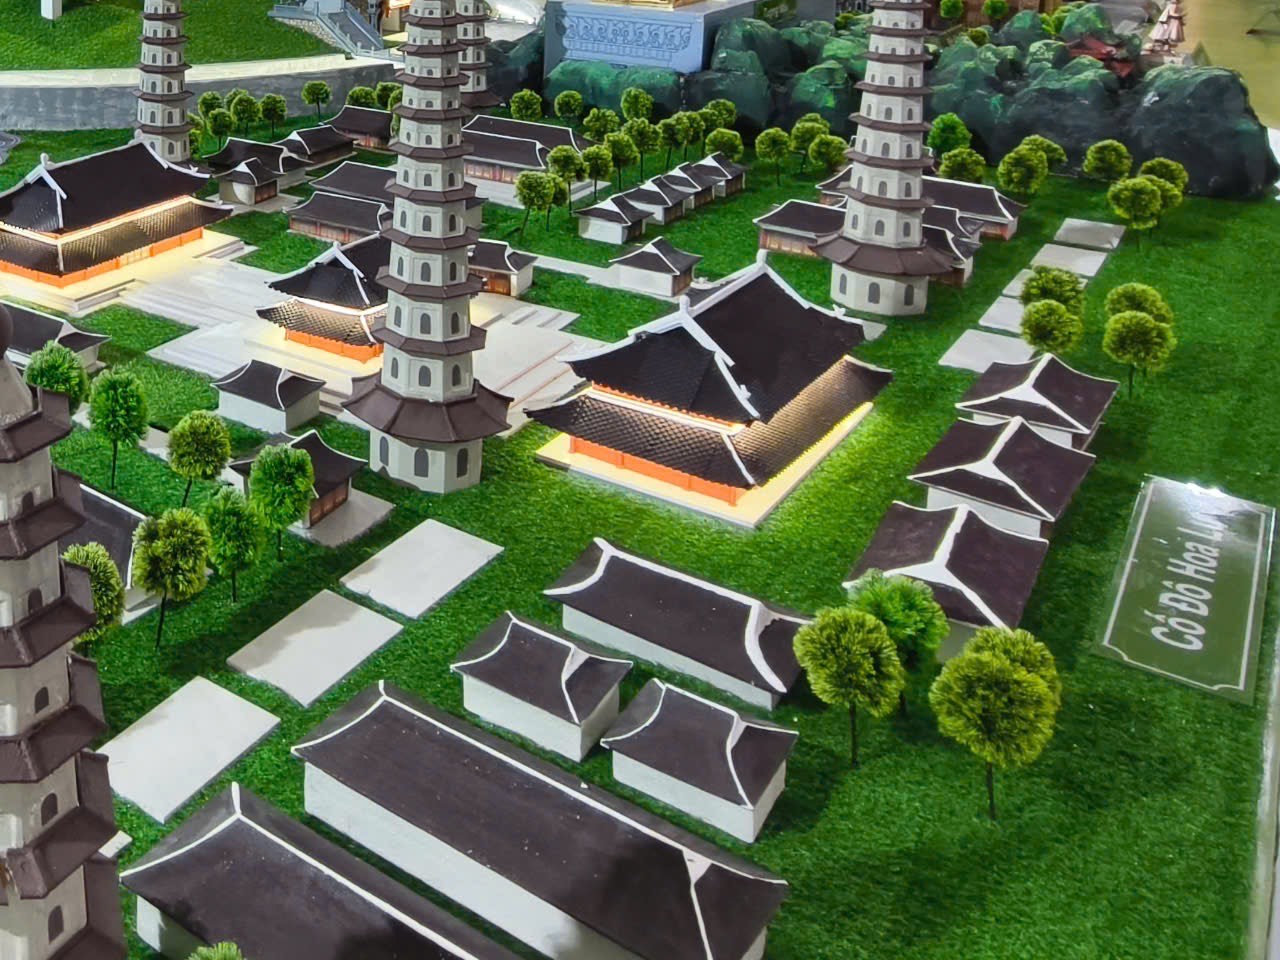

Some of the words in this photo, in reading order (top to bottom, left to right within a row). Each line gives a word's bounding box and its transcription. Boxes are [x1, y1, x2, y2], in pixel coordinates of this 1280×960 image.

[1166, 541, 1221, 583] Hoa
[1158, 580, 1213, 617] Đô
[1143, 609, 1207, 651] Cố
